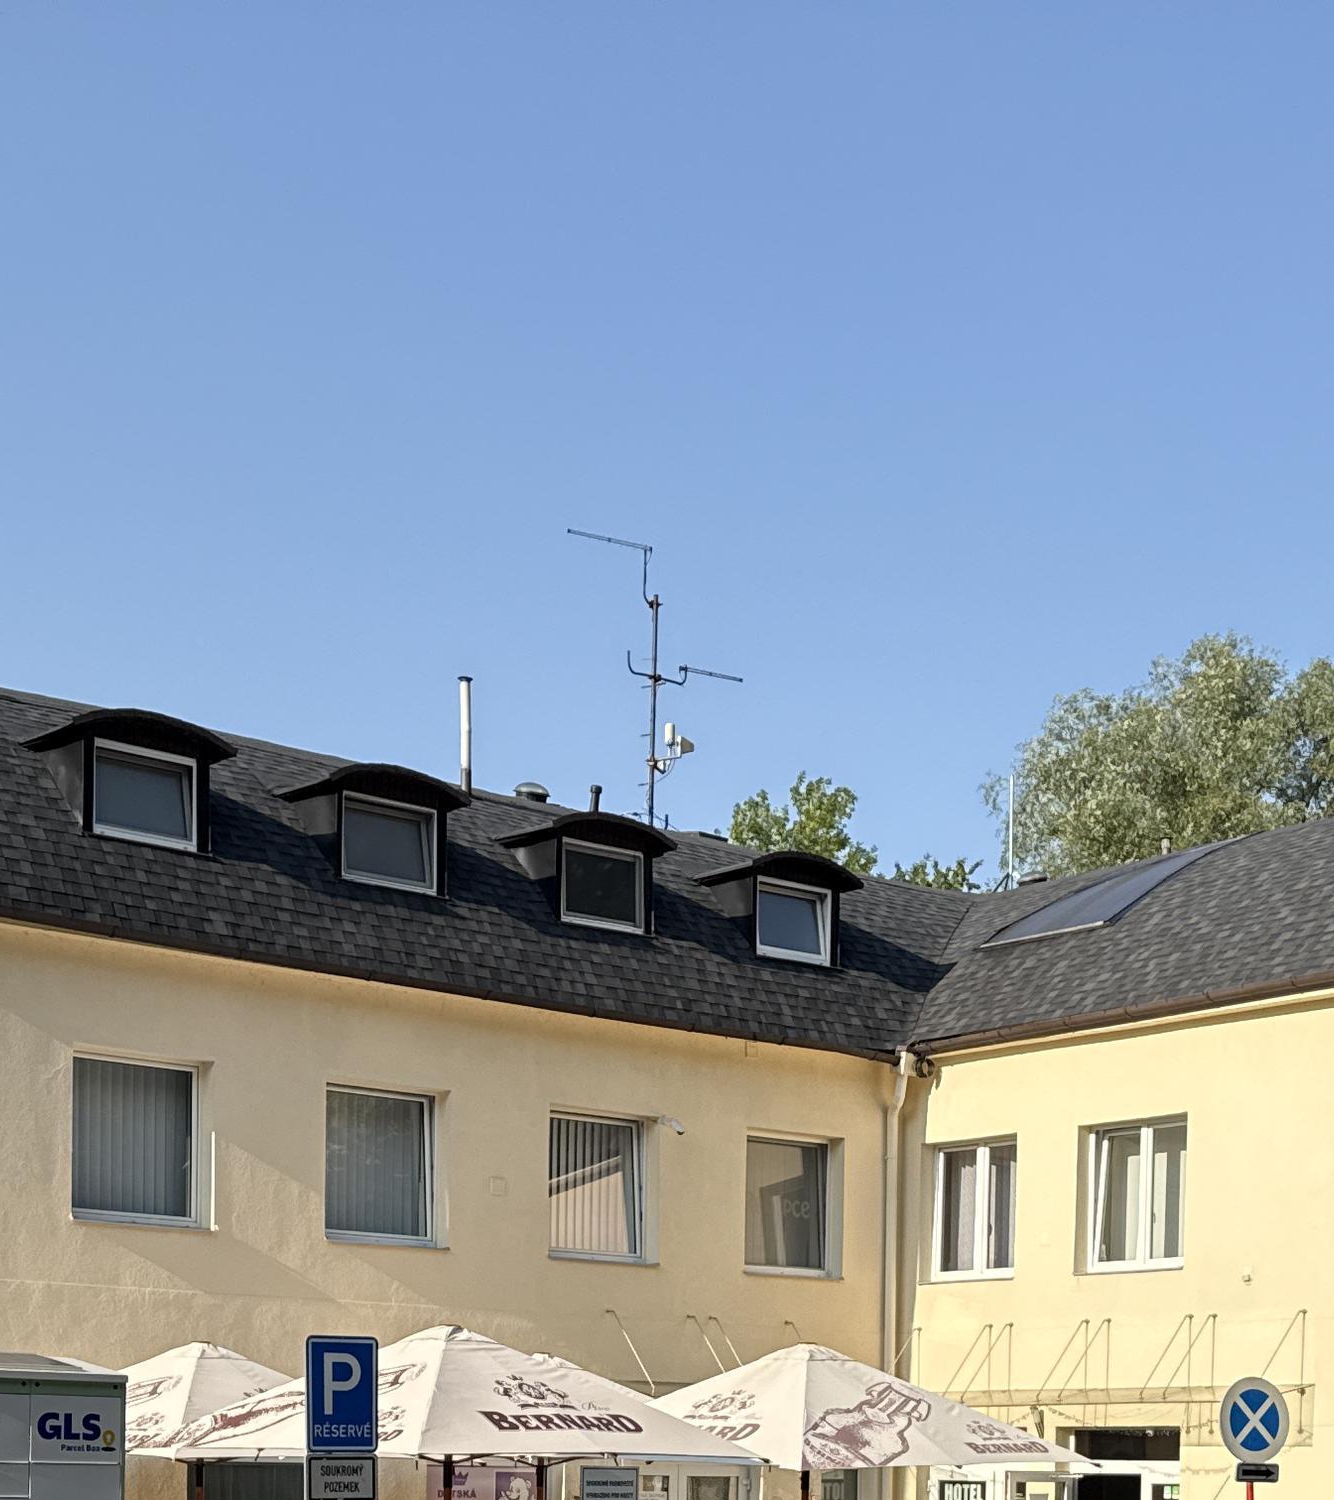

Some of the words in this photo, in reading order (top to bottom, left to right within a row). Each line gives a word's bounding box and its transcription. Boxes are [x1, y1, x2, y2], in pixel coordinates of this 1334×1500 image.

[323, 1352, 362, 1416] P
[37, 1411, 102, 1442] GLS
[314, 1421, 372, 1438] RÉSERVÉ
[477, 1410, 644, 1433] BERNARD
[964, 1441, 1049, 1454] BERNARD
[319, 1463, 365, 1478] SOUKROMÝ
[323, 1481, 361, 1494] POZEMEK
[437, 1488, 477, 1498] DTSKÁ
